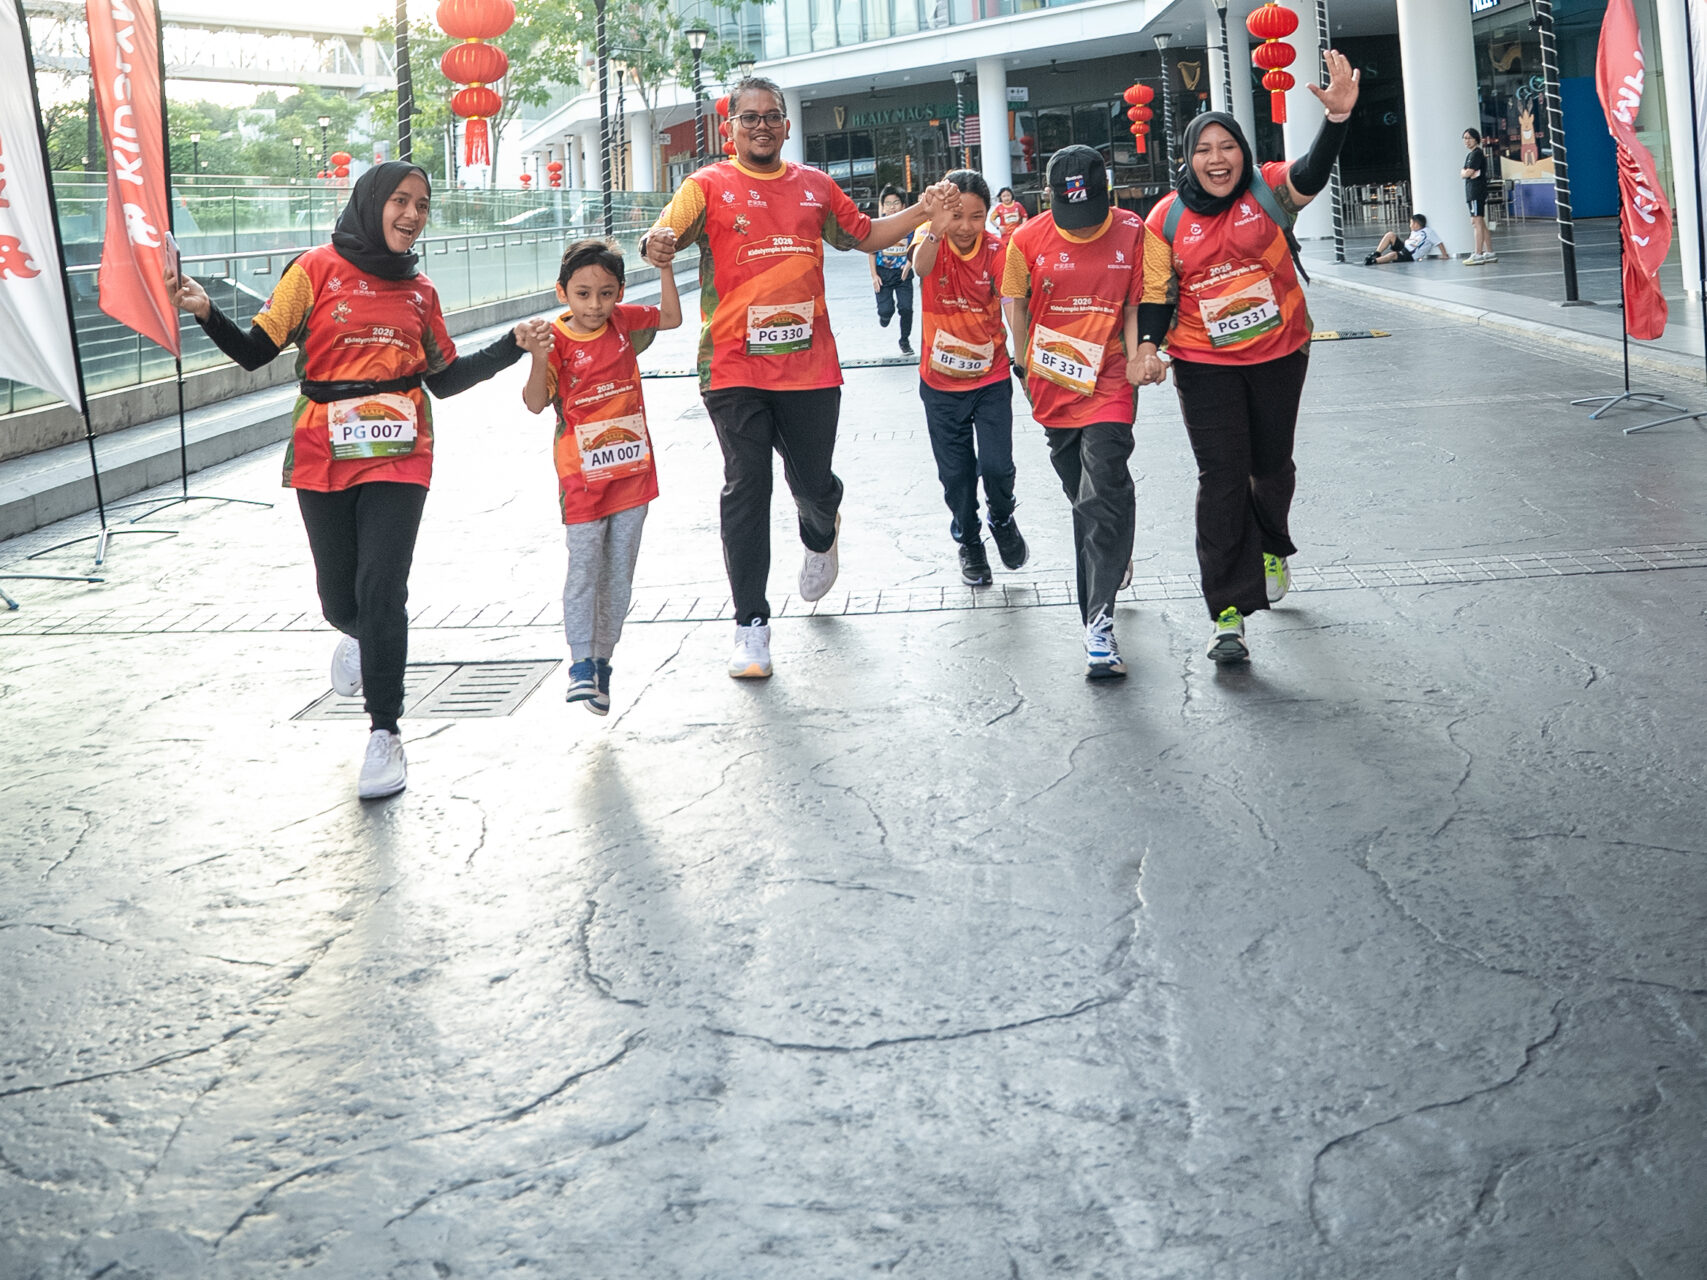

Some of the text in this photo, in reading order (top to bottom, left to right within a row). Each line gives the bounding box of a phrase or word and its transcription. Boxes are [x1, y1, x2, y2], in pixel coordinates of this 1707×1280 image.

[852, 110, 891, 127] HEALY
[1218, 319, 1240, 333] PG
[1242, 308, 1267, 327] 331
[759, 328, 803, 342] PG 330
[940, 354, 982, 370] BF 330
[1042, 352, 1057, 367] BF
[1059, 361, 1083, 378] 331
[343, 425, 402, 441] PG 007
[592, 445, 640, 467] AM 007
